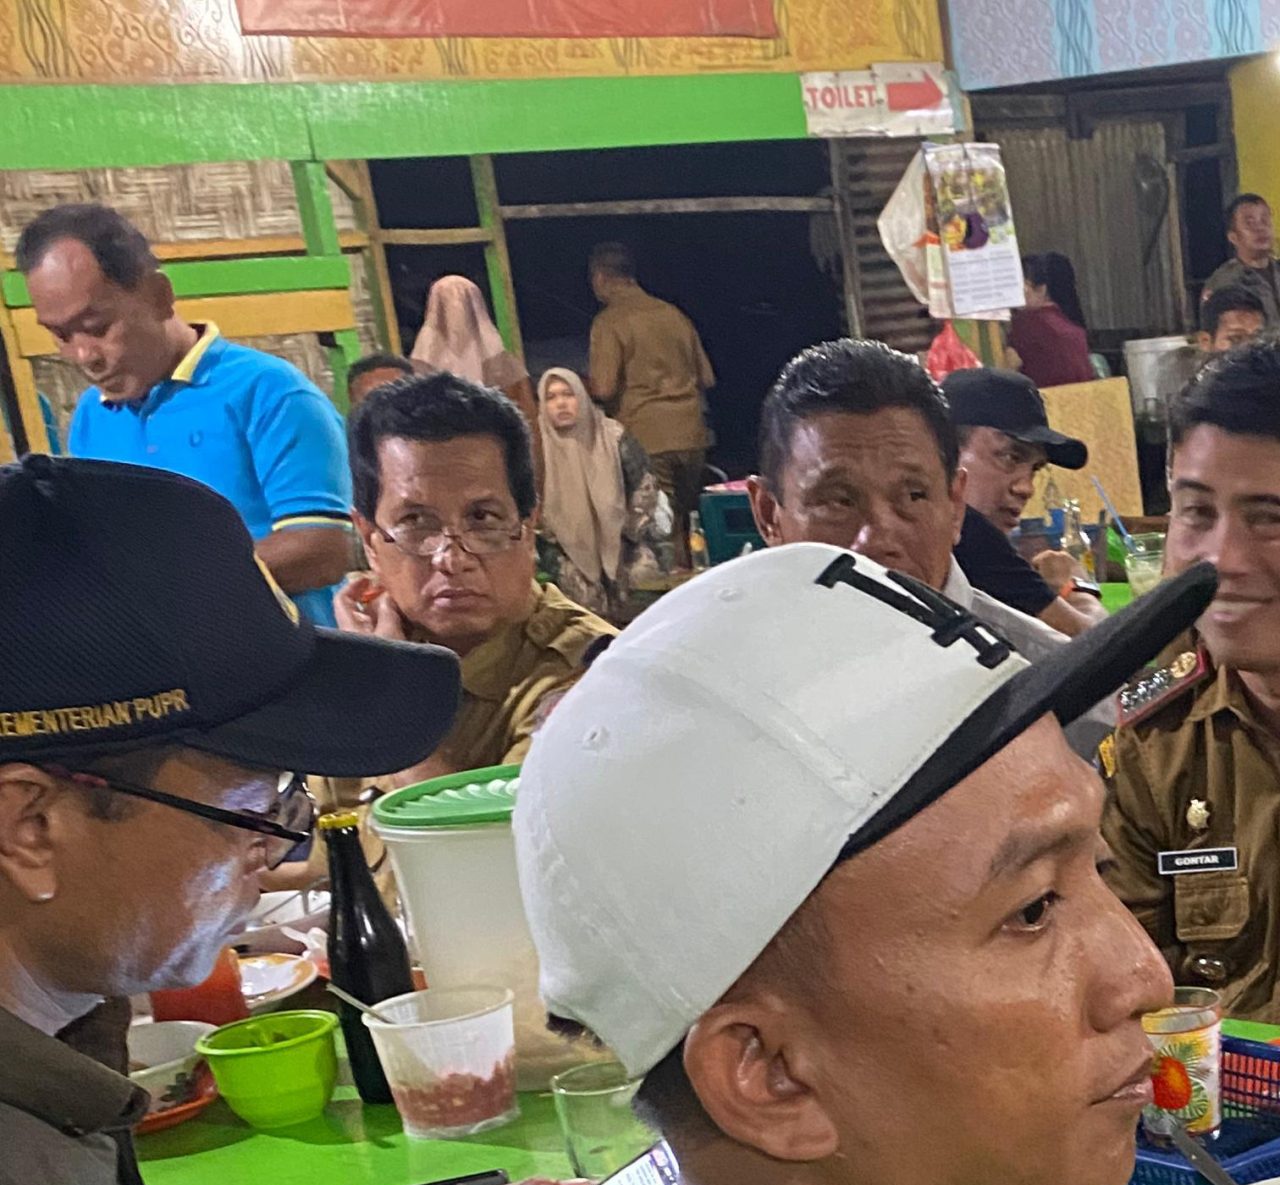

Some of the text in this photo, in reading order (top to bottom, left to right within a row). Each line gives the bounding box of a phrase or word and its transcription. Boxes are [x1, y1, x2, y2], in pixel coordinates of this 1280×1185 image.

[805, 84, 877, 110] TOILET
[133, 688, 191, 720] PUPR
[1174, 855, 1220, 867] GONTAR
